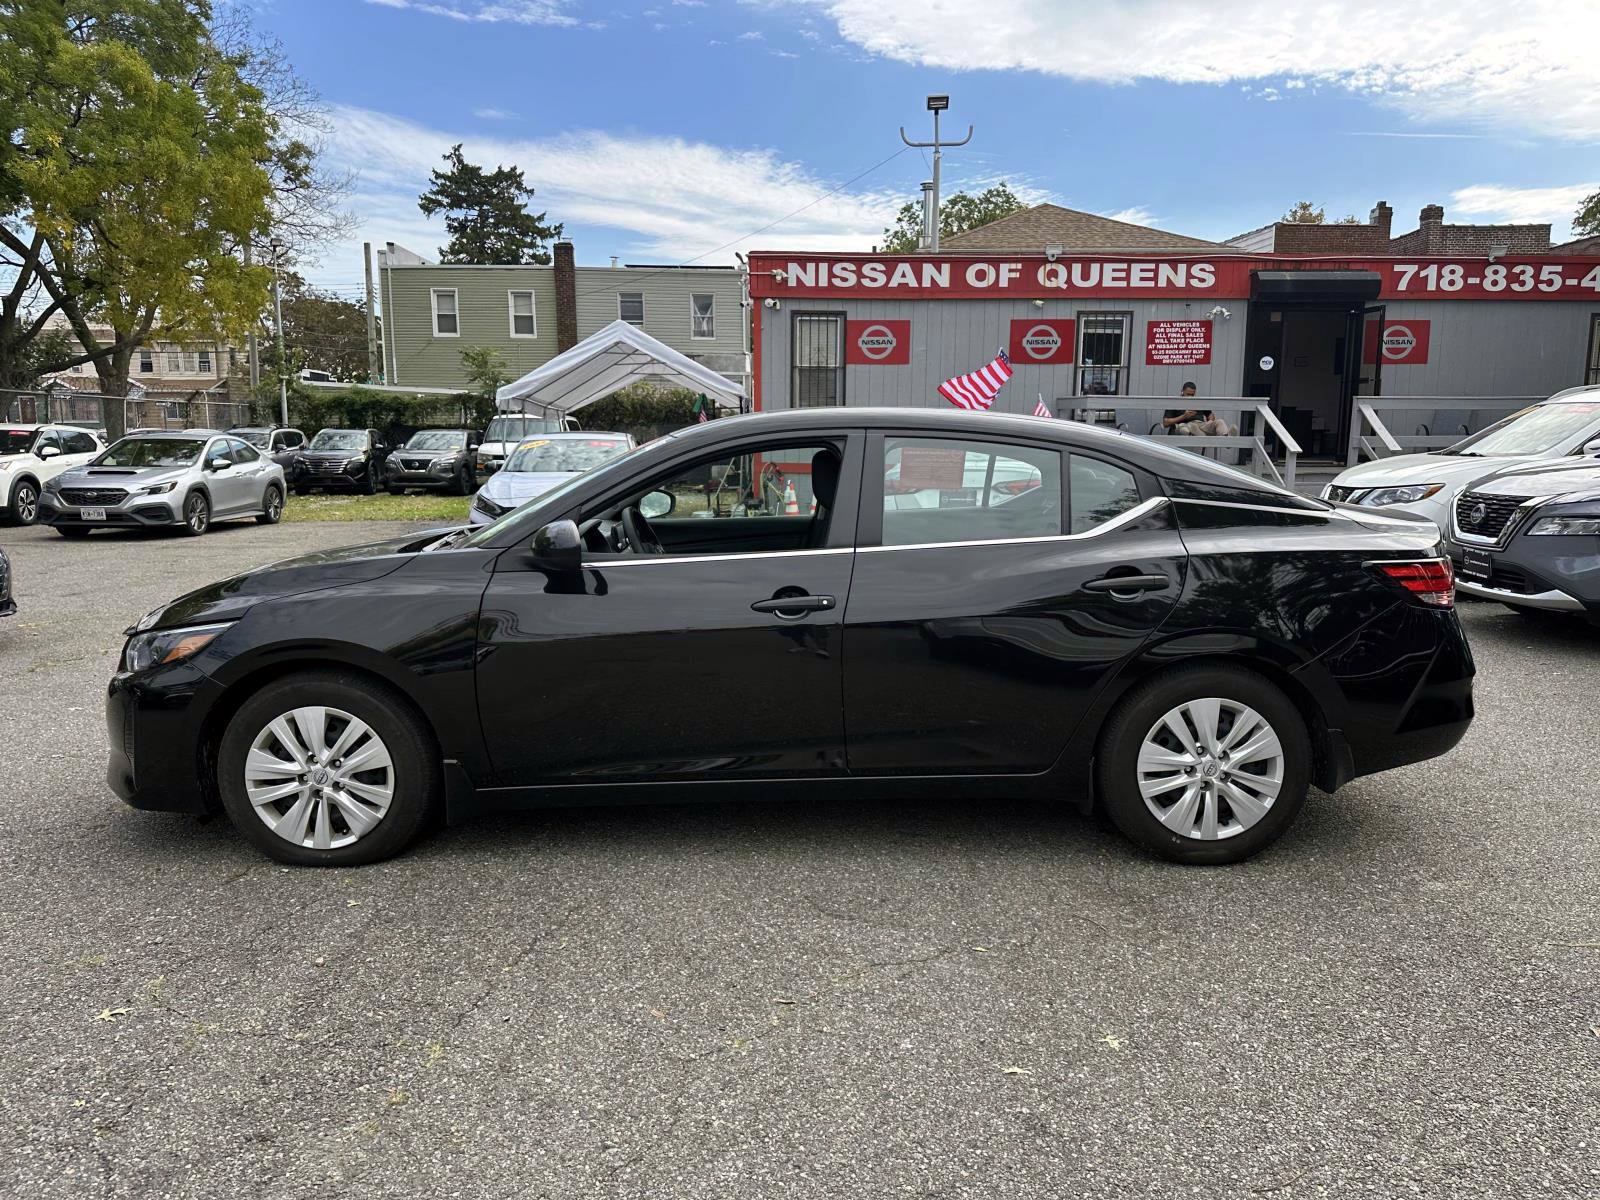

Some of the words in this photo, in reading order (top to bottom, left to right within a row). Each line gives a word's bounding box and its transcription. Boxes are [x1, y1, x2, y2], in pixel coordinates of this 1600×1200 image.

[787, 262, 950, 287] NISSAN
[965, 263, 1022, 287] OF
[1037, 263, 1216, 289] QUEENS
[1393, 264, 1600, 292] 718-835-4
